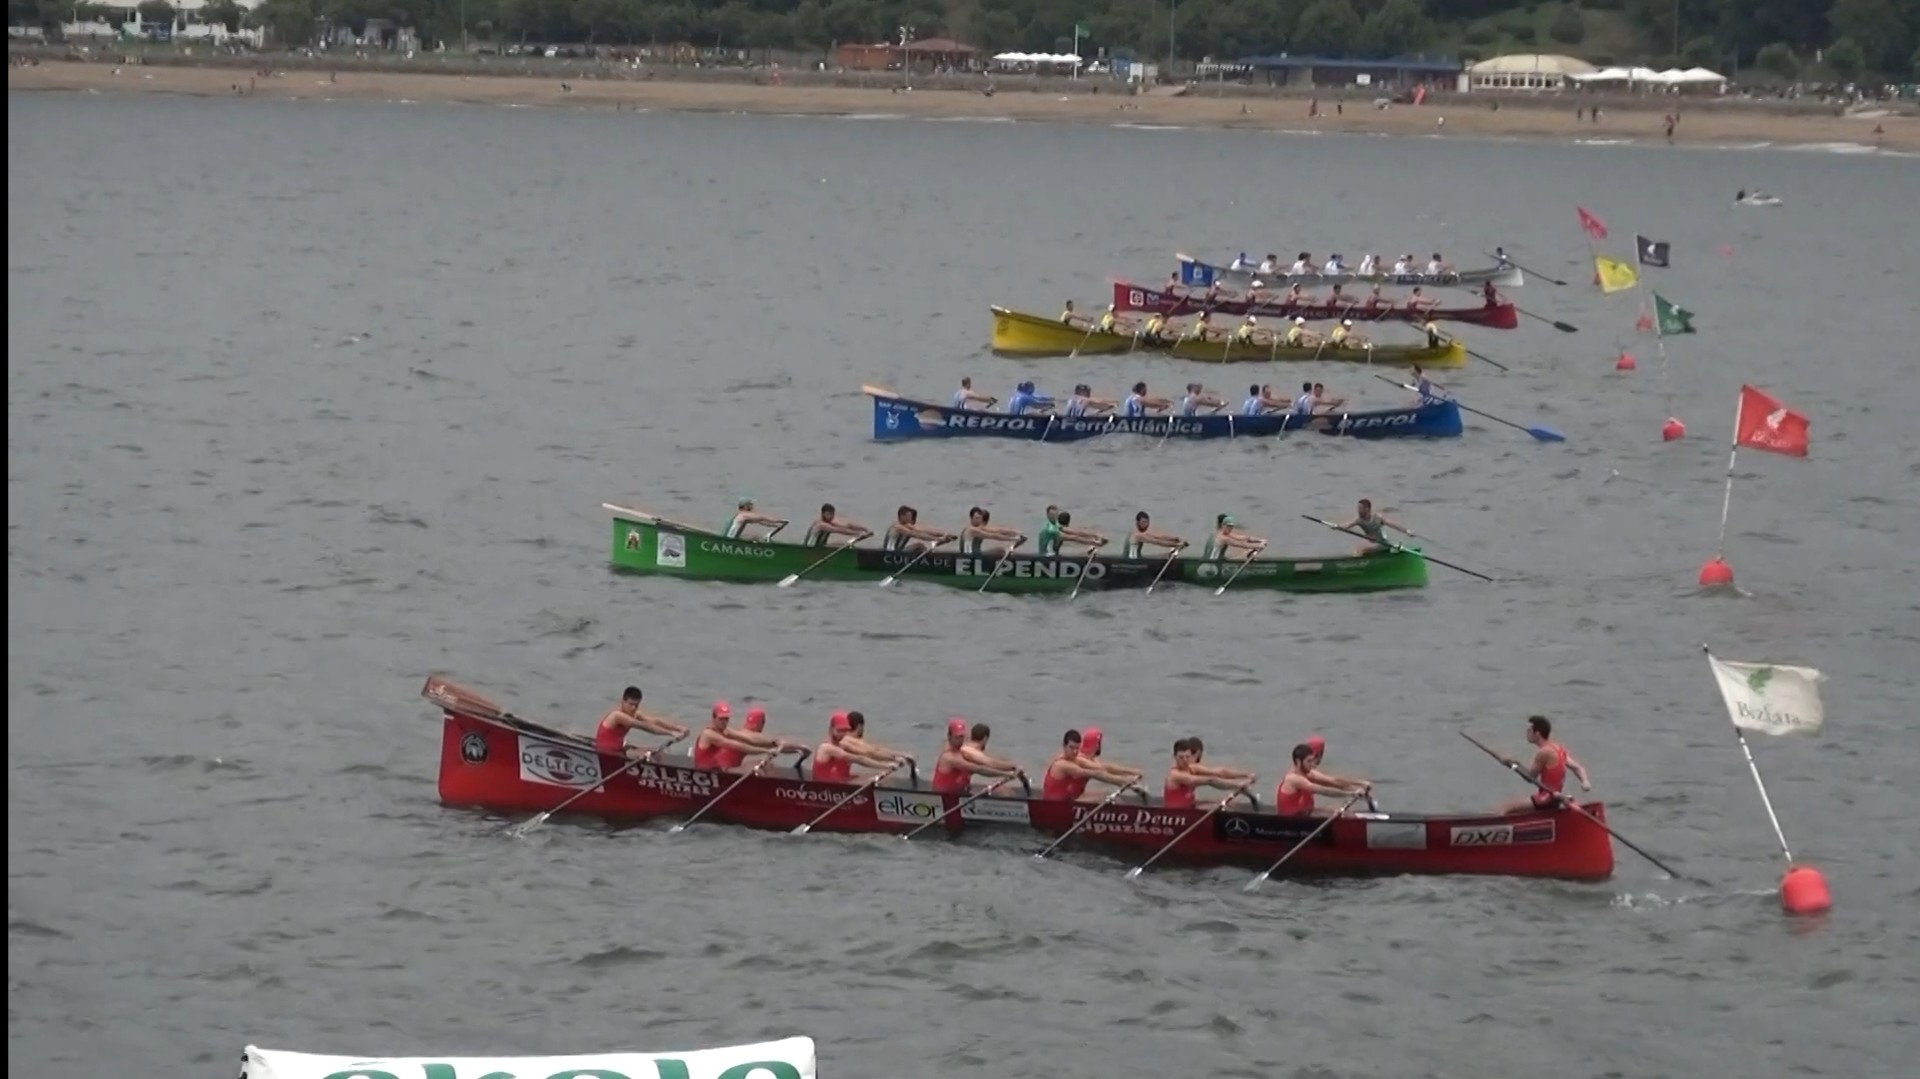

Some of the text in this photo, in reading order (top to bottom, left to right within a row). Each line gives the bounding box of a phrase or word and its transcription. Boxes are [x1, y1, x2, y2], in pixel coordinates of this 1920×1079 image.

[949, 414, 1036, 431] REPSOL
[700, 540, 776, 558] CAMARGO
[522, 751, 599, 778] DELTECO
[877, 795, 937, 819] elkor
